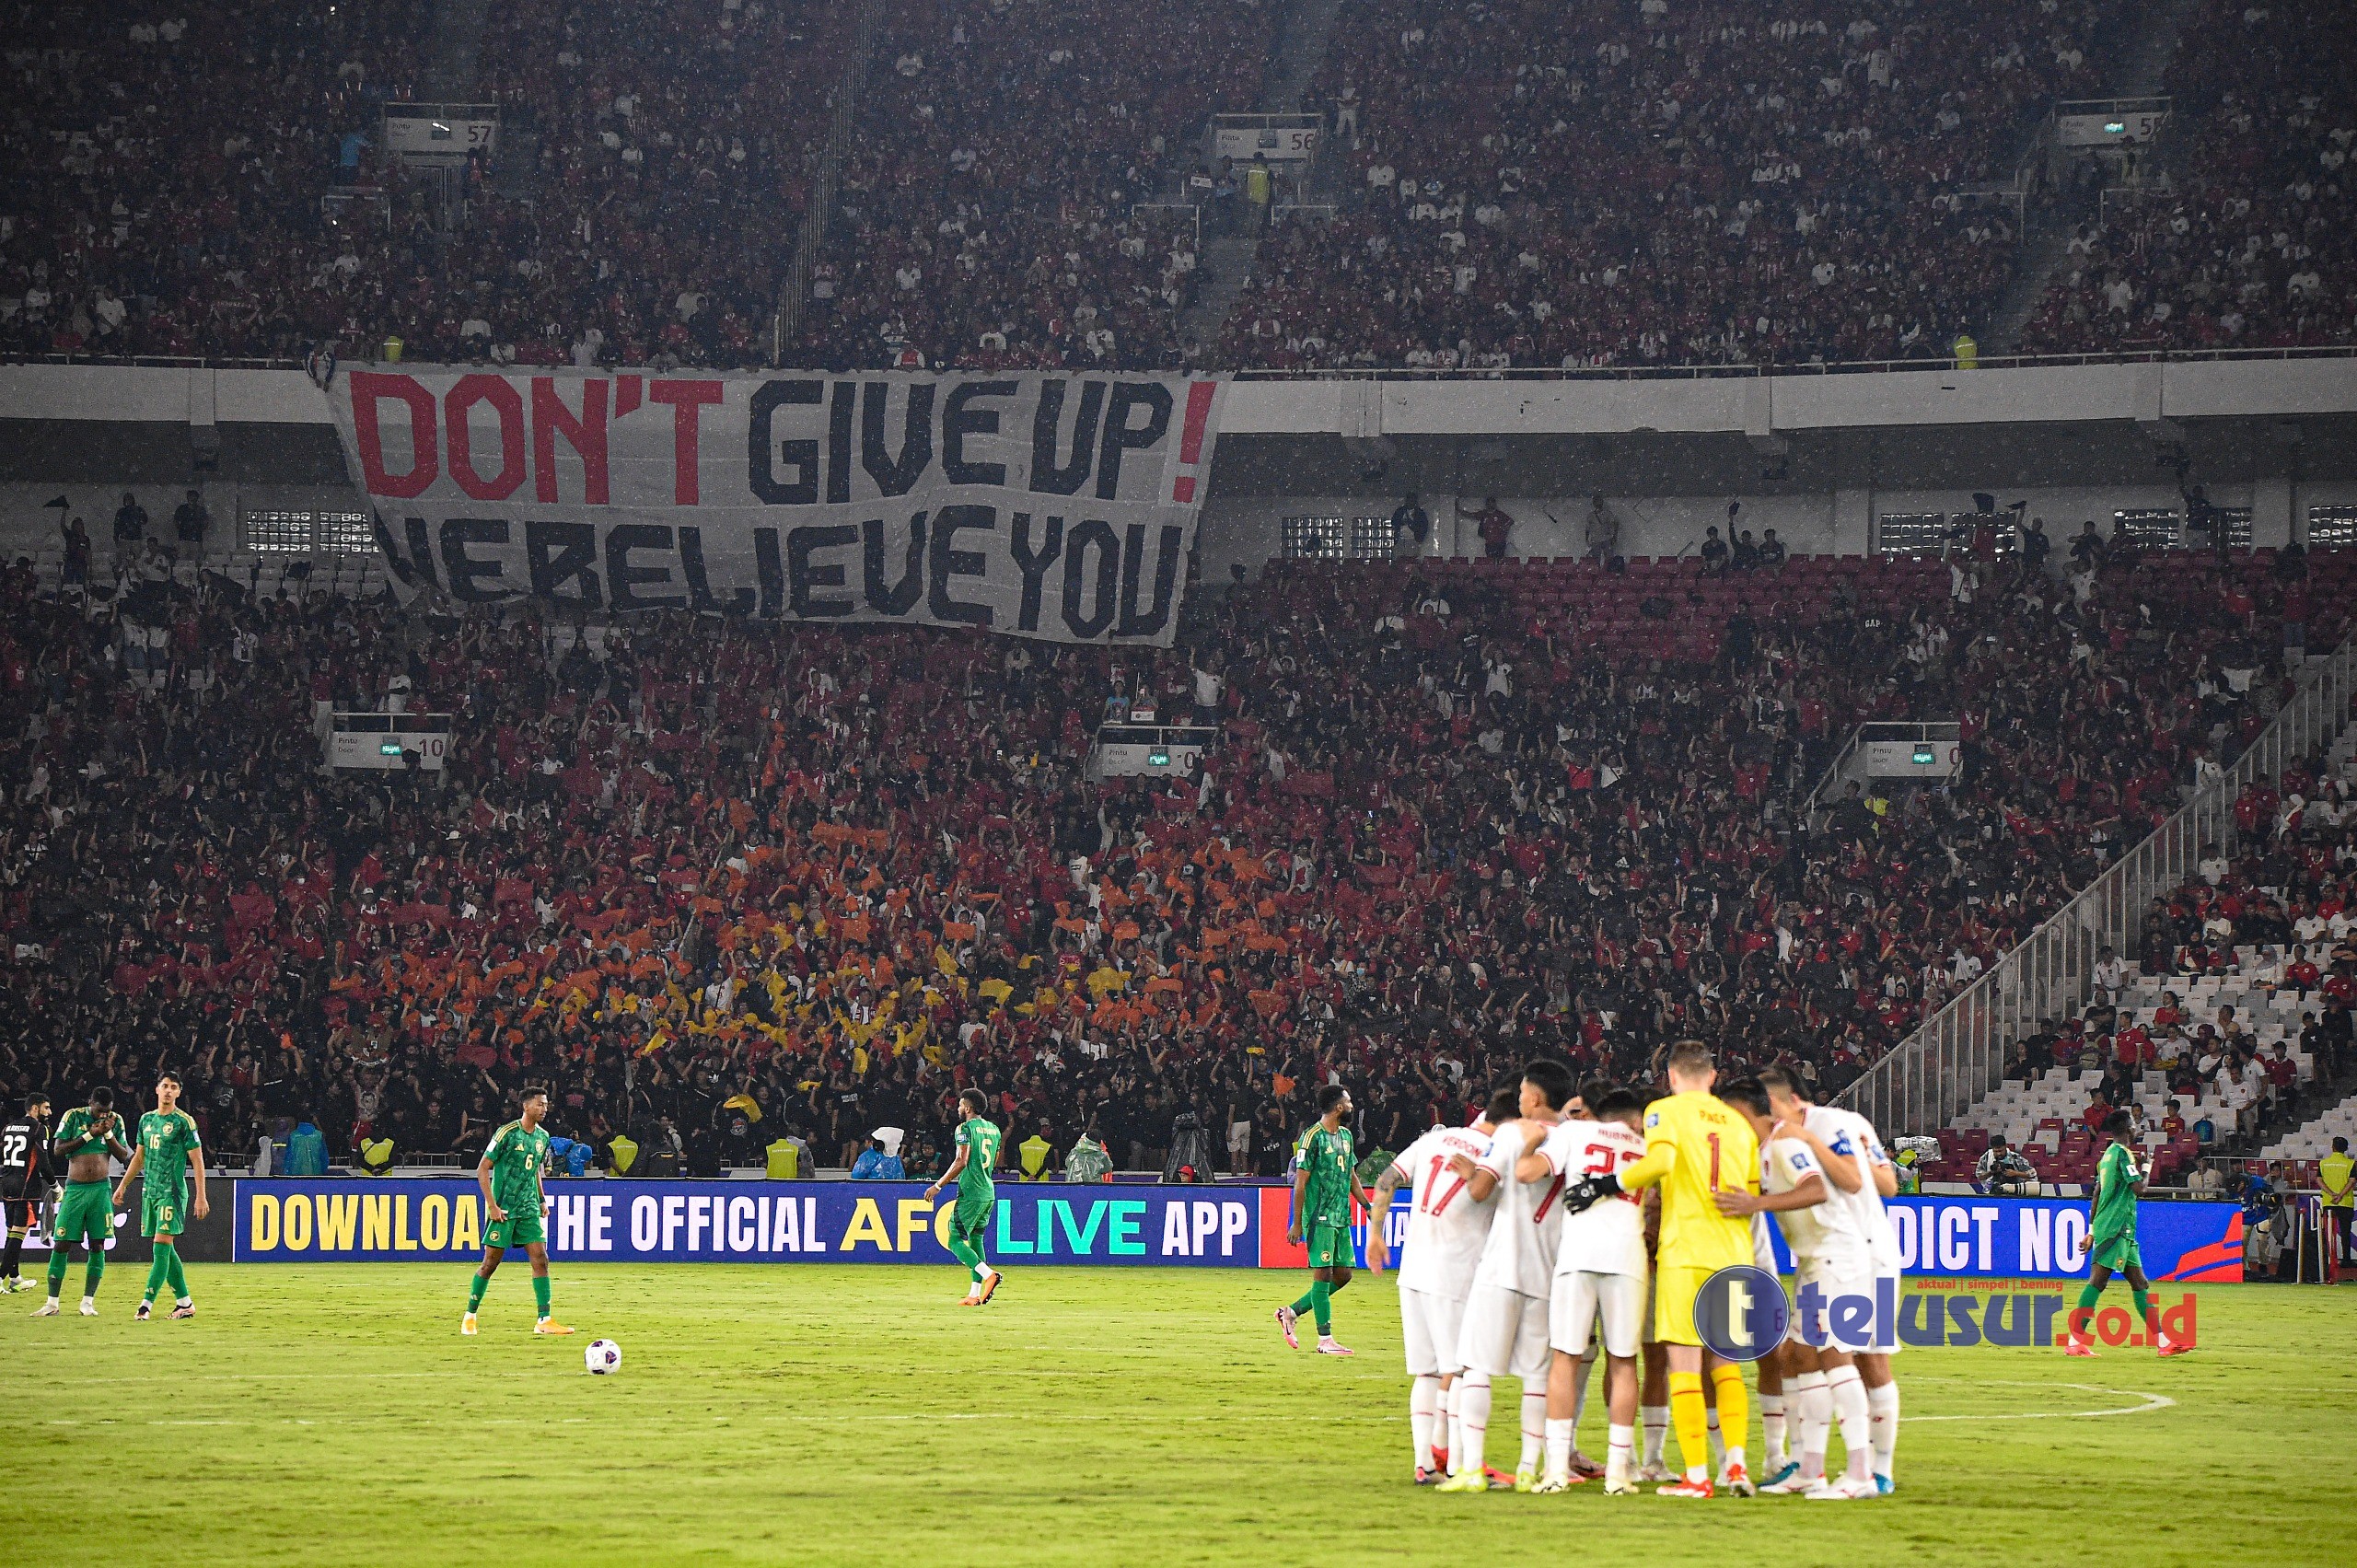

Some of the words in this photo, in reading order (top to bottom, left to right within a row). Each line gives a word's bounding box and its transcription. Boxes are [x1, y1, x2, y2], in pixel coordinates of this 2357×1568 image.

[468, 125, 492, 143] 57
[350, 372, 724, 505] DON'T
[749, 379, 1019, 505] GIVE
[1029, 378, 1217, 503] UP!
[1010, 513, 1183, 639] YOU
[1864, 619, 1881, 628] GAP
[419, 738, 444, 757] 10
[4, 1134, 28, 1167] 22
[150, 1133, 161, 1149] 16
[981, 1138, 993, 1169] 5
[525, 1154, 534, 1169] 6
[1337, 1155, 1345, 1173] 9
[1707, 1132, 1720, 1192] 1
[1421, 1155, 1468, 1217] 17
[159, 1205, 173, 1222] 16
[250, 1194, 489, 1251] DOWNLOA
[631, 1194, 826, 1252] OFFICIAL
[997, 1199, 1147, 1256] LIVE
[1162, 1201, 1248, 1257] APP
[2019, 1207, 2091, 1273] NO
